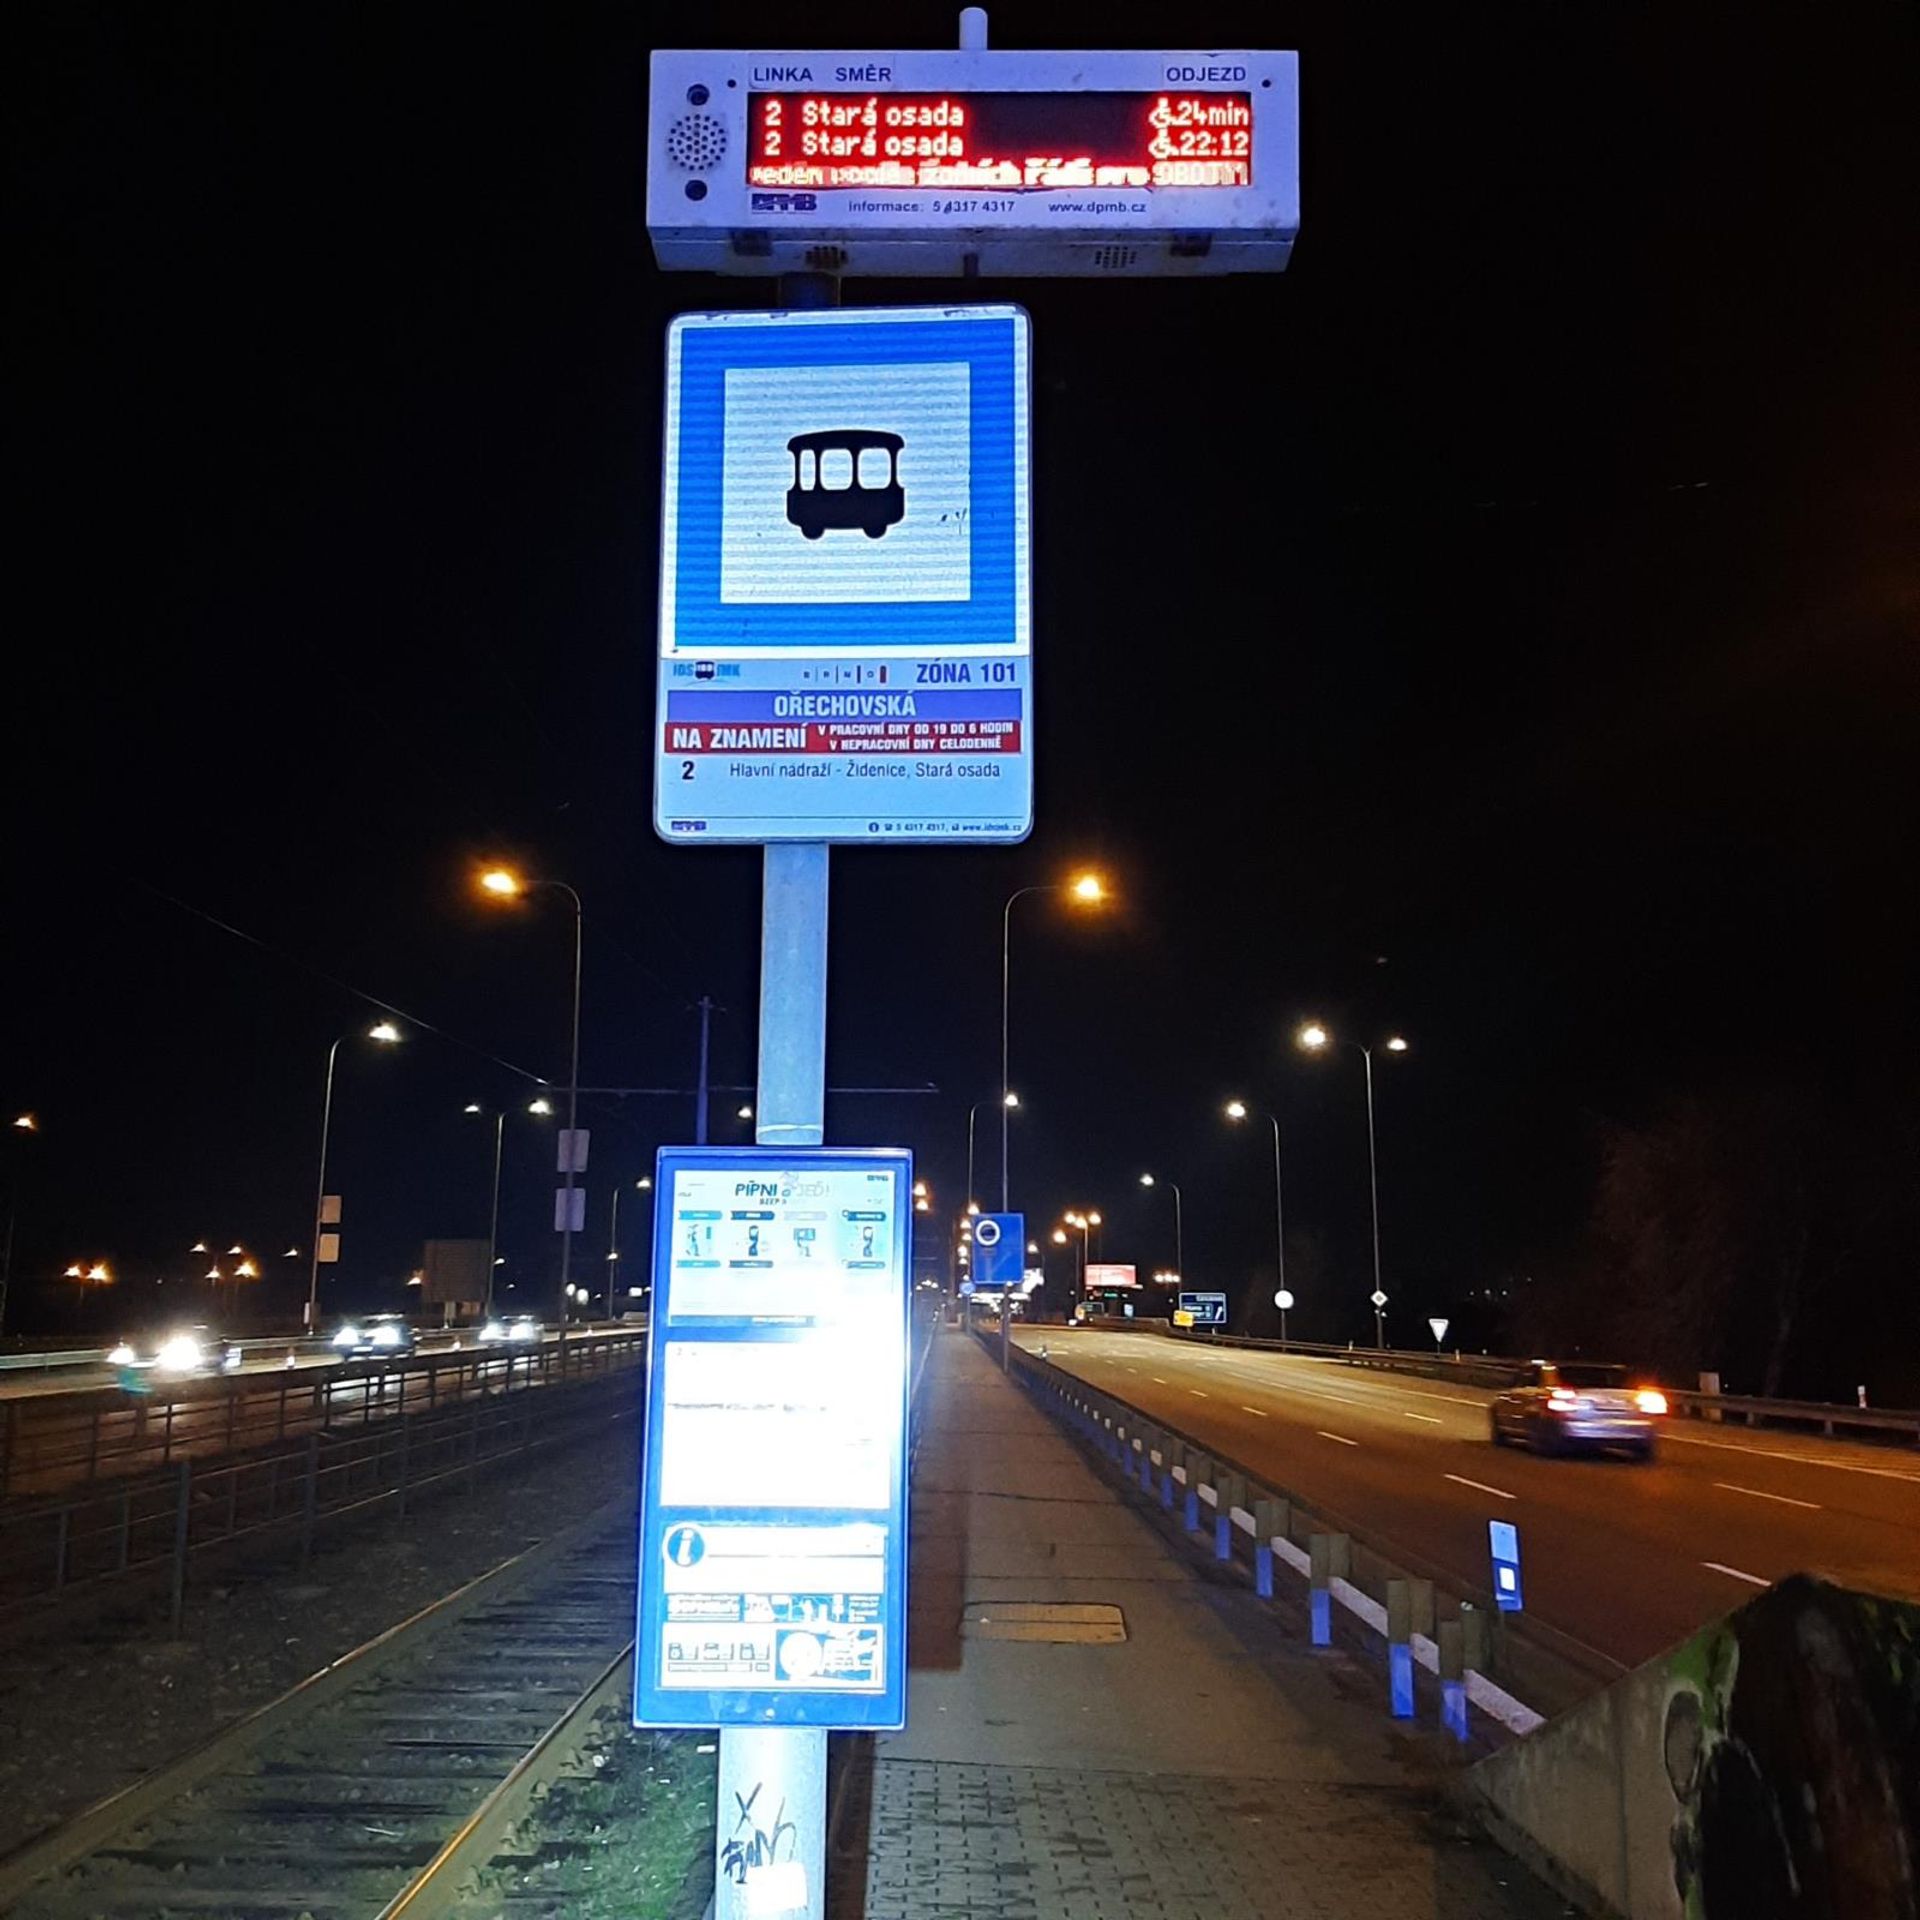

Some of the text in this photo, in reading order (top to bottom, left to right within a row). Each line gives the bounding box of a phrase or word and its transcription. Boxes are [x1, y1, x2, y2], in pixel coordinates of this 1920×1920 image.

[753, 63, 892, 82] LINKA SMĚR
[1166, 67, 1247, 82] ODJEZD
[765, 98, 964, 127] 2 Stará osada
[764, 128, 964, 157] 2 Stará osada
[1180, 132, 1249, 156] 22:12
[982, 201, 1015, 212] 4317
[1048, 201, 1147, 215] www.dpmb.cz
[916, 658, 1016, 684] ZÓNA 101
[773, 690, 917, 717] OŘECHOVSKÁ
[672, 723, 808, 749] NA ZNAMENÍ
[818, 725, 826, 736] V
[830, 722, 885, 736] PRACOVNÍ
[888, 723, 910, 735] DNY
[914, 724, 930, 735] OD
[934, 724, 947, 735] 19
[951, 723, 966, 734] DO
[980, 722, 1013, 734] HODIN
[829, 740, 837, 751] V
[841, 737, 910, 751] NEPRACOVNÍ
[913, 739, 936, 750] DNY
[682, 761, 695, 780] 2
[730, 762, 774, 777] Hlavní
[779, 760, 832, 778] nádraží
[846, 759, 911, 779] Židenice,
[915, 761, 953, 778] Stará
[957, 762, 1001, 778] osada
[735, 1180, 778, 1197] PÍPNI
